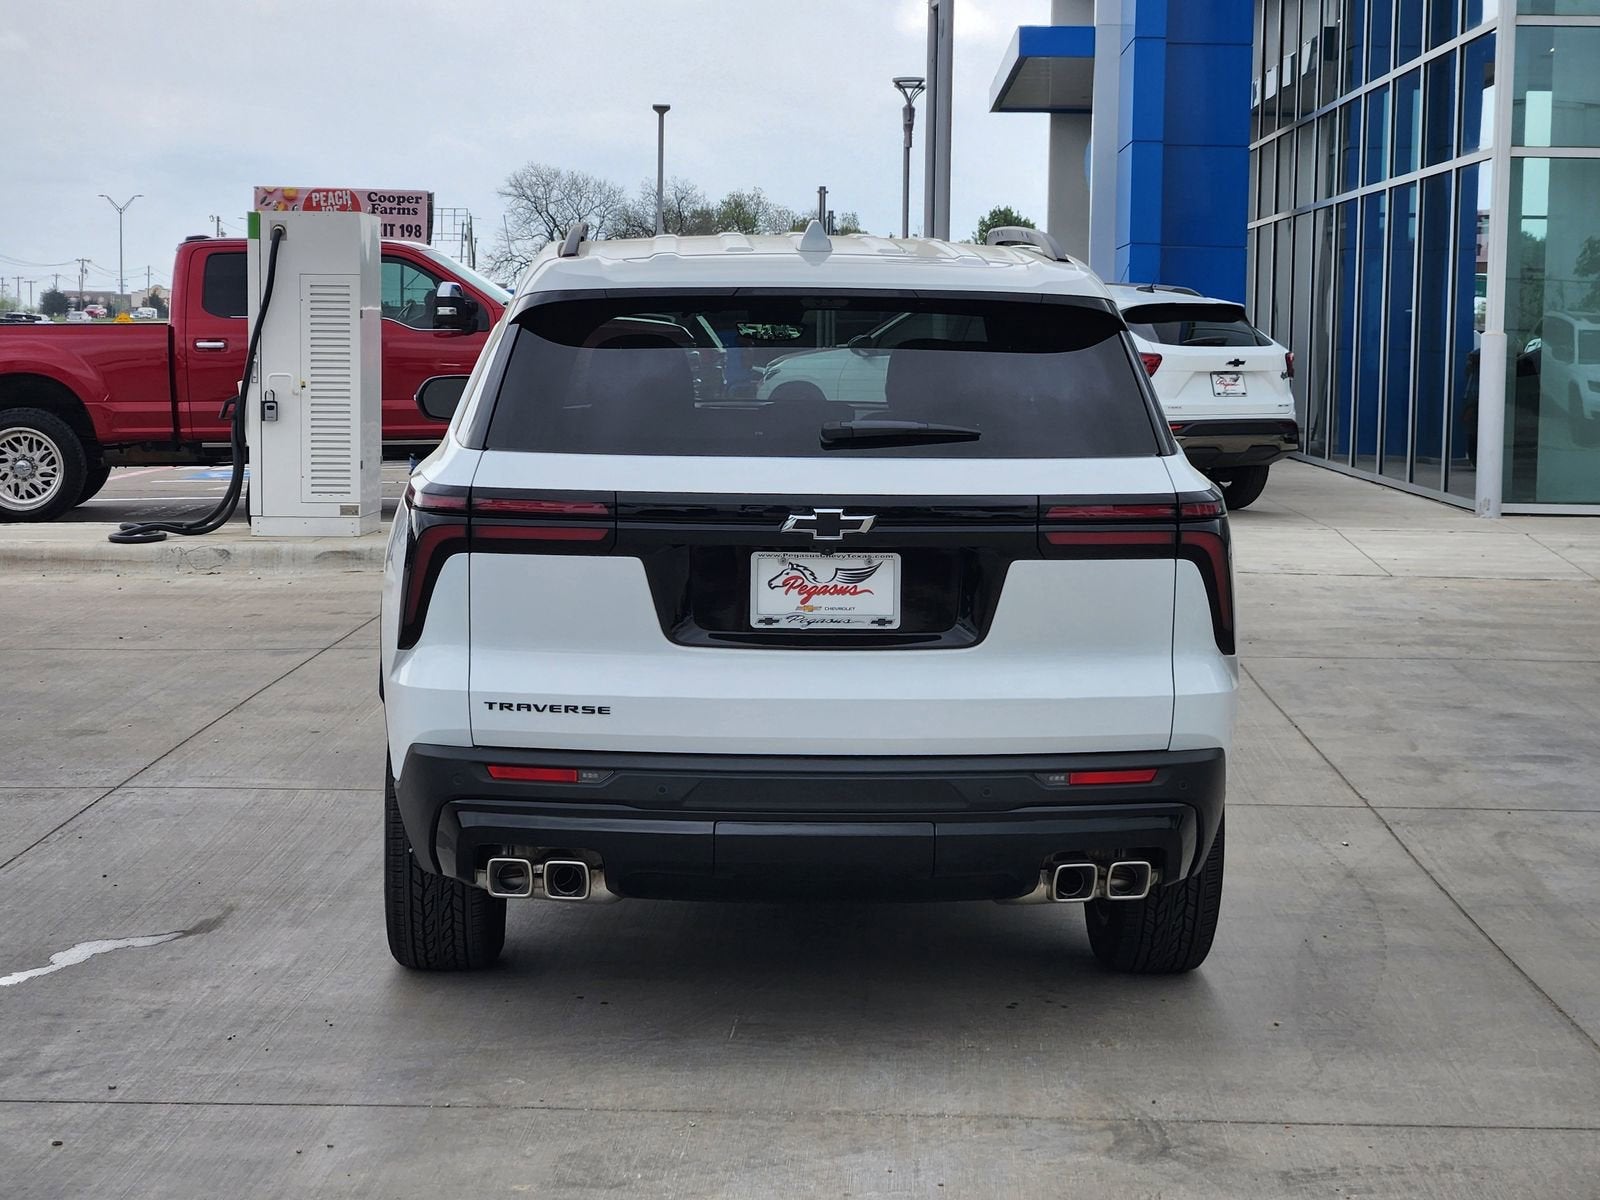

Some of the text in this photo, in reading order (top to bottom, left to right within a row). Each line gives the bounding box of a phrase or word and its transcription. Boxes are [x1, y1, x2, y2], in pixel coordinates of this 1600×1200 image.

[311, 190, 351, 207] PEACH
[367, 192, 422, 206] Cooper
[371, 203, 418, 216] Farms
[380, 223, 422, 239] IT 198
[782, 575, 874, 605] Pegasus
[785, 614, 865, 628] Pegasus
[483, 701, 611, 715] TRAVERSE
